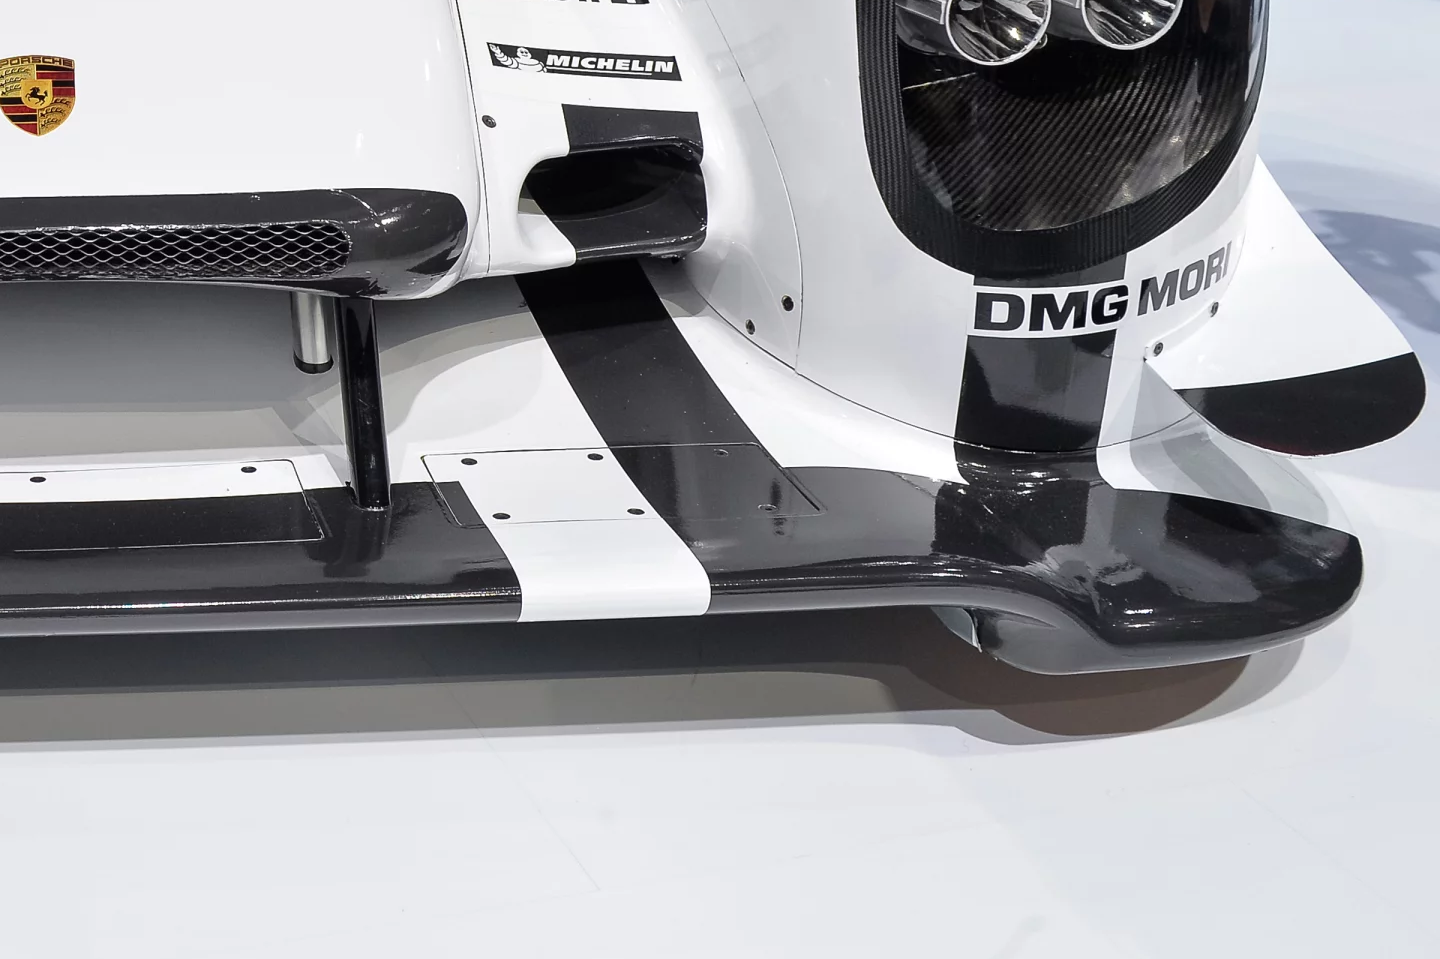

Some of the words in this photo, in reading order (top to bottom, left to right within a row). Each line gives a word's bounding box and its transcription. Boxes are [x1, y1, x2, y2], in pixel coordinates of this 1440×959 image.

[546, 54, 675, 74] MICHELIN
[973, 284, 1129, 332] DMG
[1137, 240, 1233, 317] MORI
